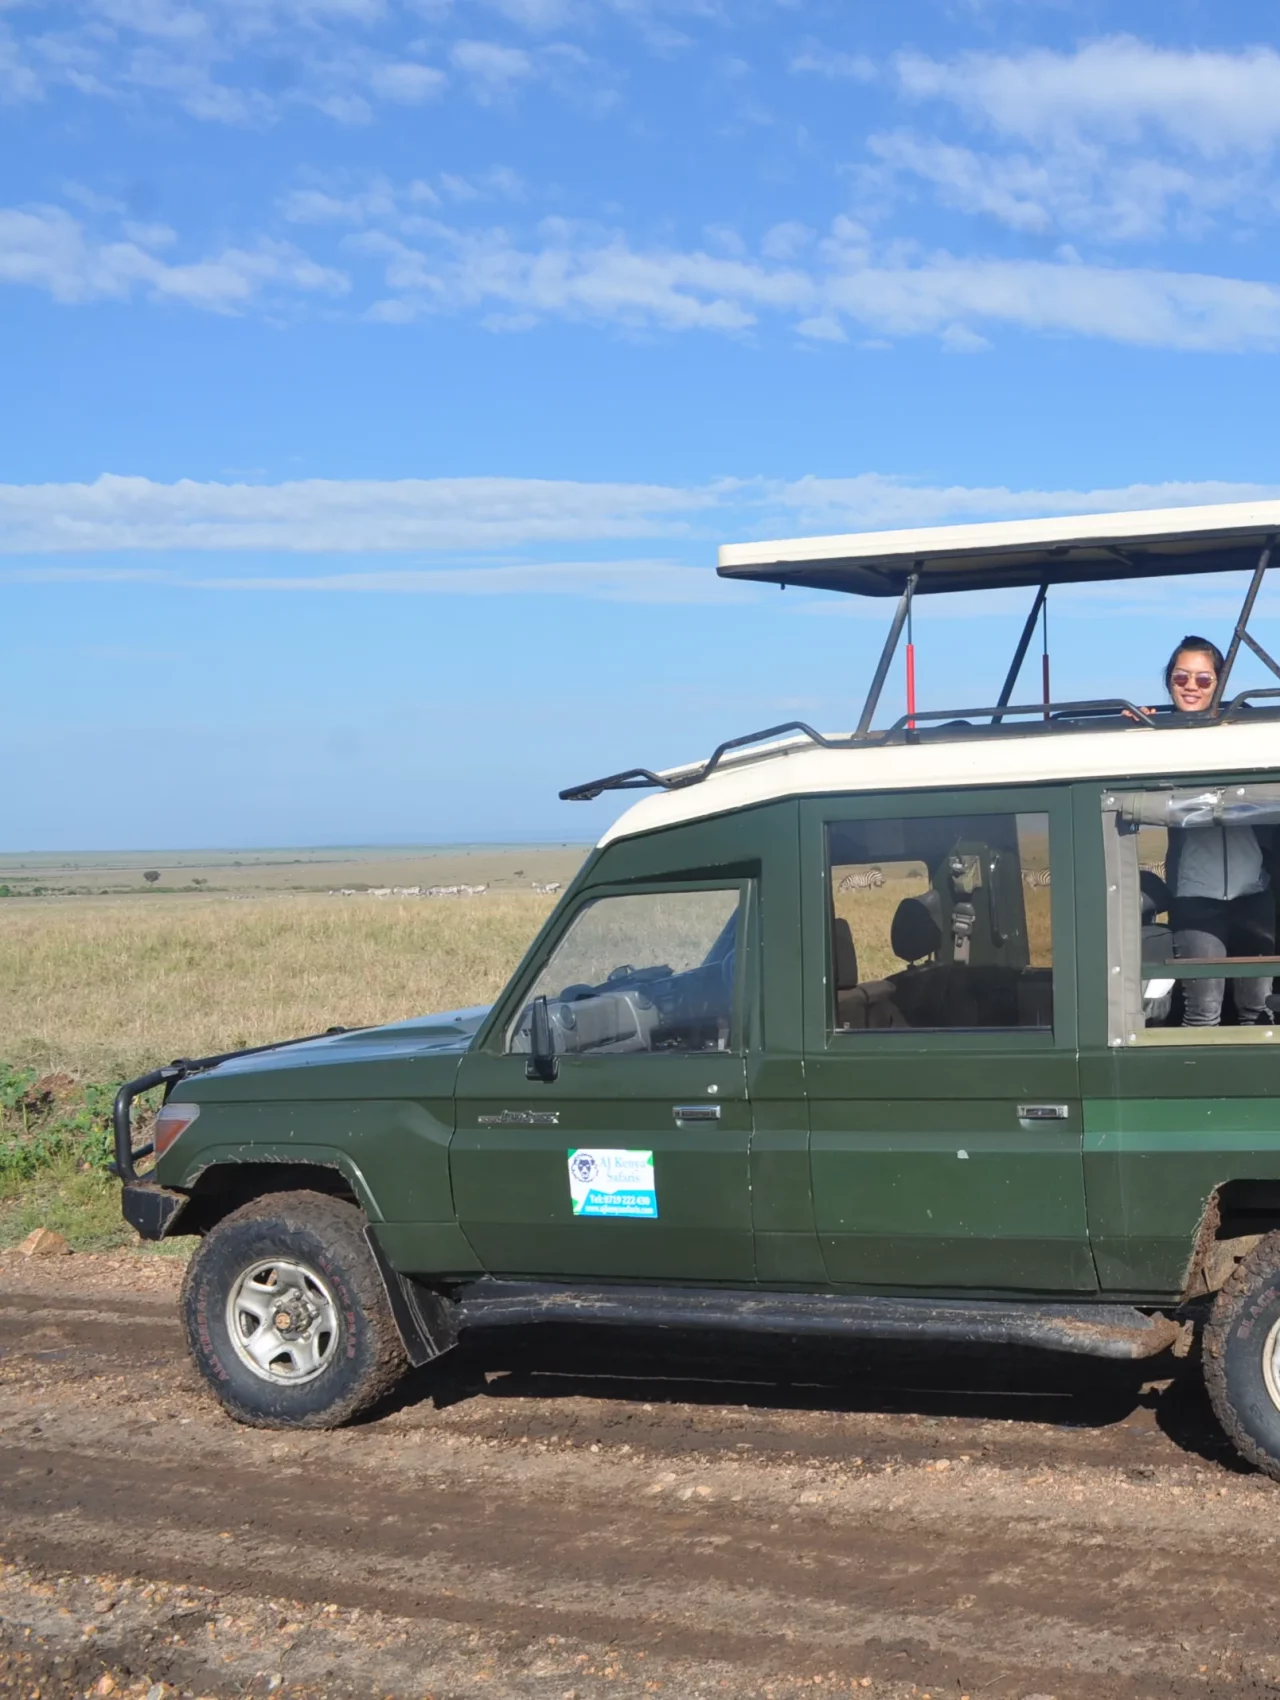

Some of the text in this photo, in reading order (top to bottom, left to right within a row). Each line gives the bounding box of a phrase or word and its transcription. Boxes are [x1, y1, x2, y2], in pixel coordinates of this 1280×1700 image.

[614, 1156, 646, 1169] Kenya
[606, 1170, 641, 1182] Safaris
[1236, 1286, 1280, 1340] BLACK
